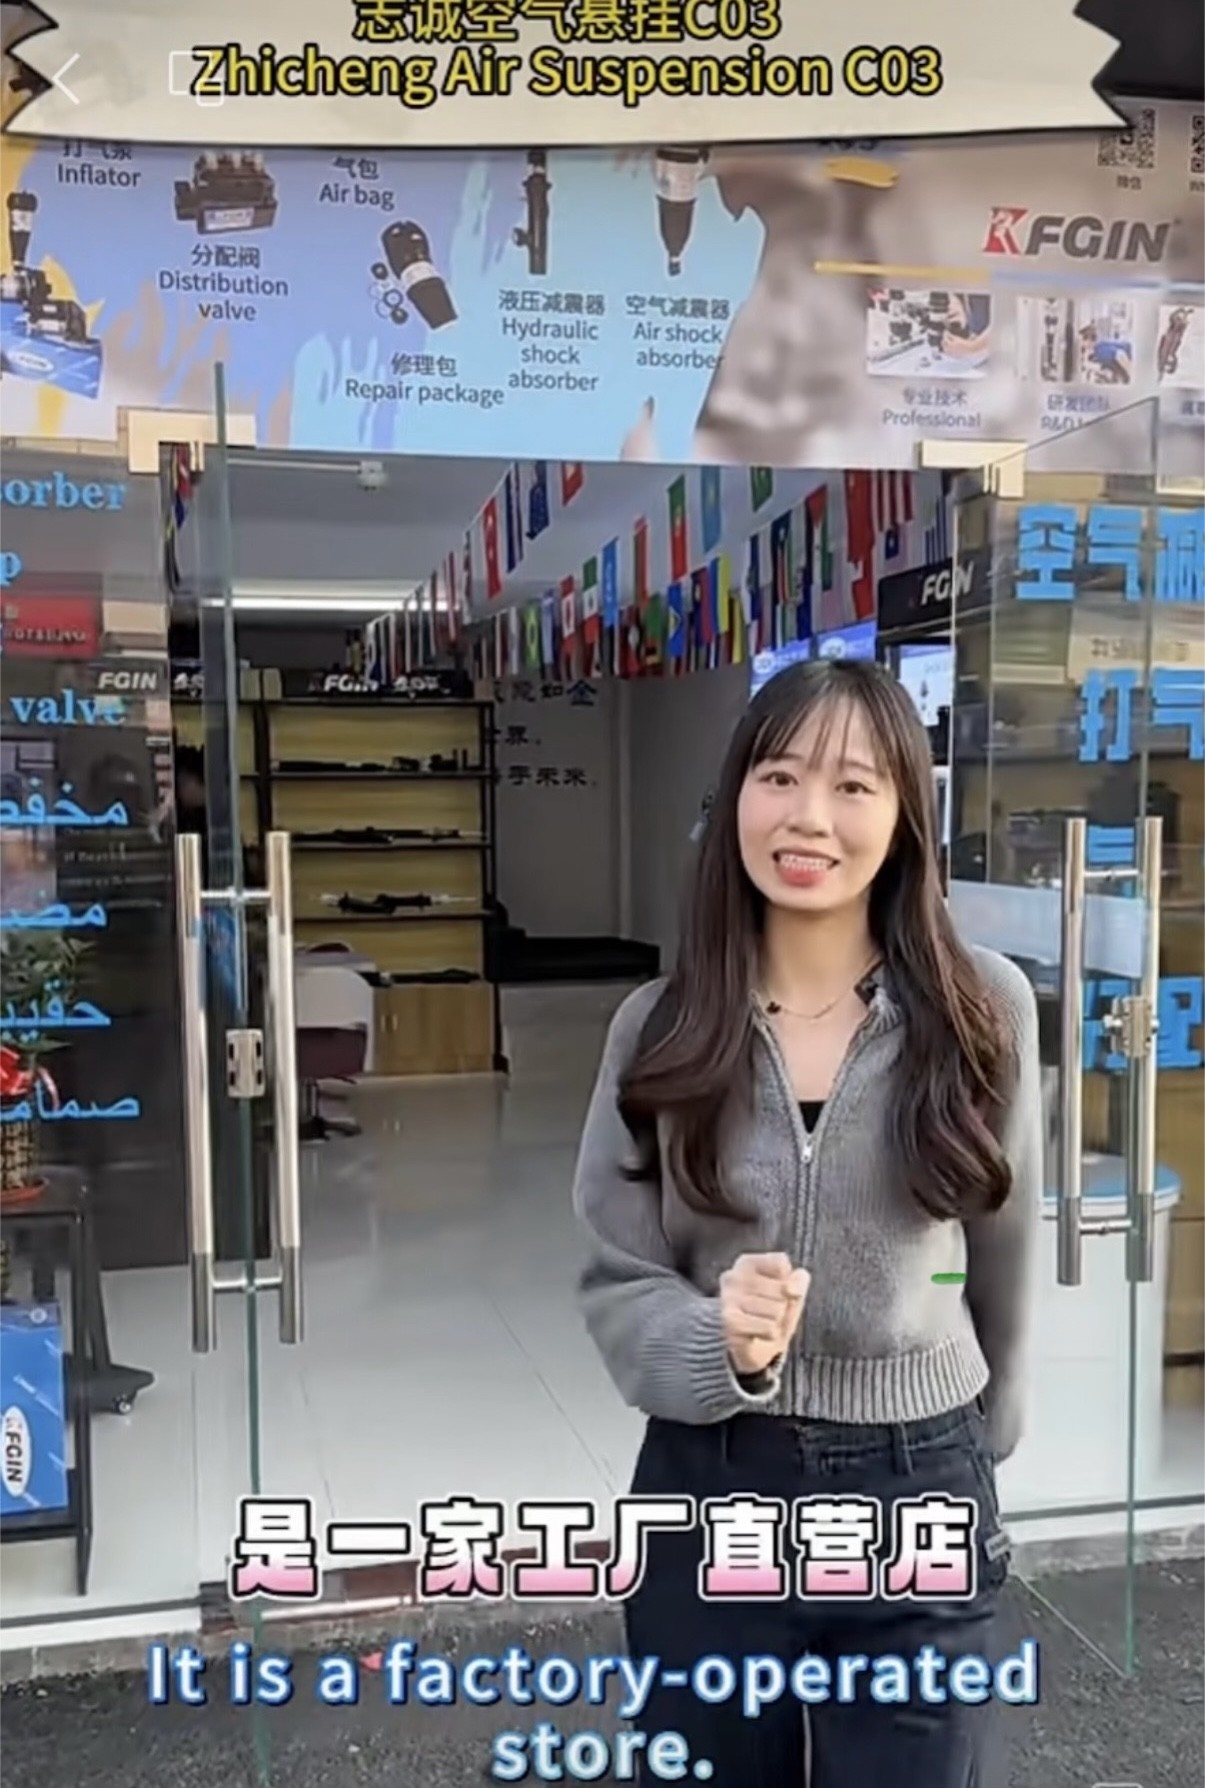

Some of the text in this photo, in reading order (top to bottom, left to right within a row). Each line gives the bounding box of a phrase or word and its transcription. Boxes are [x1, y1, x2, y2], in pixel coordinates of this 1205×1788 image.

[58, 163, 142, 187] Inflator
[332, 155, 379, 180] 气包
[319, 183, 395, 212] Air bag
[191, 243, 260, 269] 分配阀
[159, 270, 289, 296] Distribution
[198, 299, 257, 321] valve
[498, 288, 605, 317] 液压减震器
[625, 294, 731, 320] 空气减震器
[501, 317, 599, 341] Hydraulic
[633, 322, 723, 344] Air shock
[391, 352, 458, 378] 修理包
[520, 346, 581, 365] shock
[635, 350, 724, 370] absorber
[508, 369, 599, 393] absorber
[345, 379, 505, 409] Repair package
[882, 408, 981, 429] Professional
[0, 471, 128, 509] orber
[919, 561, 975, 606] FGN
[98, 672, 158, 691] FGIN
[10, 689, 127, 726] valve
